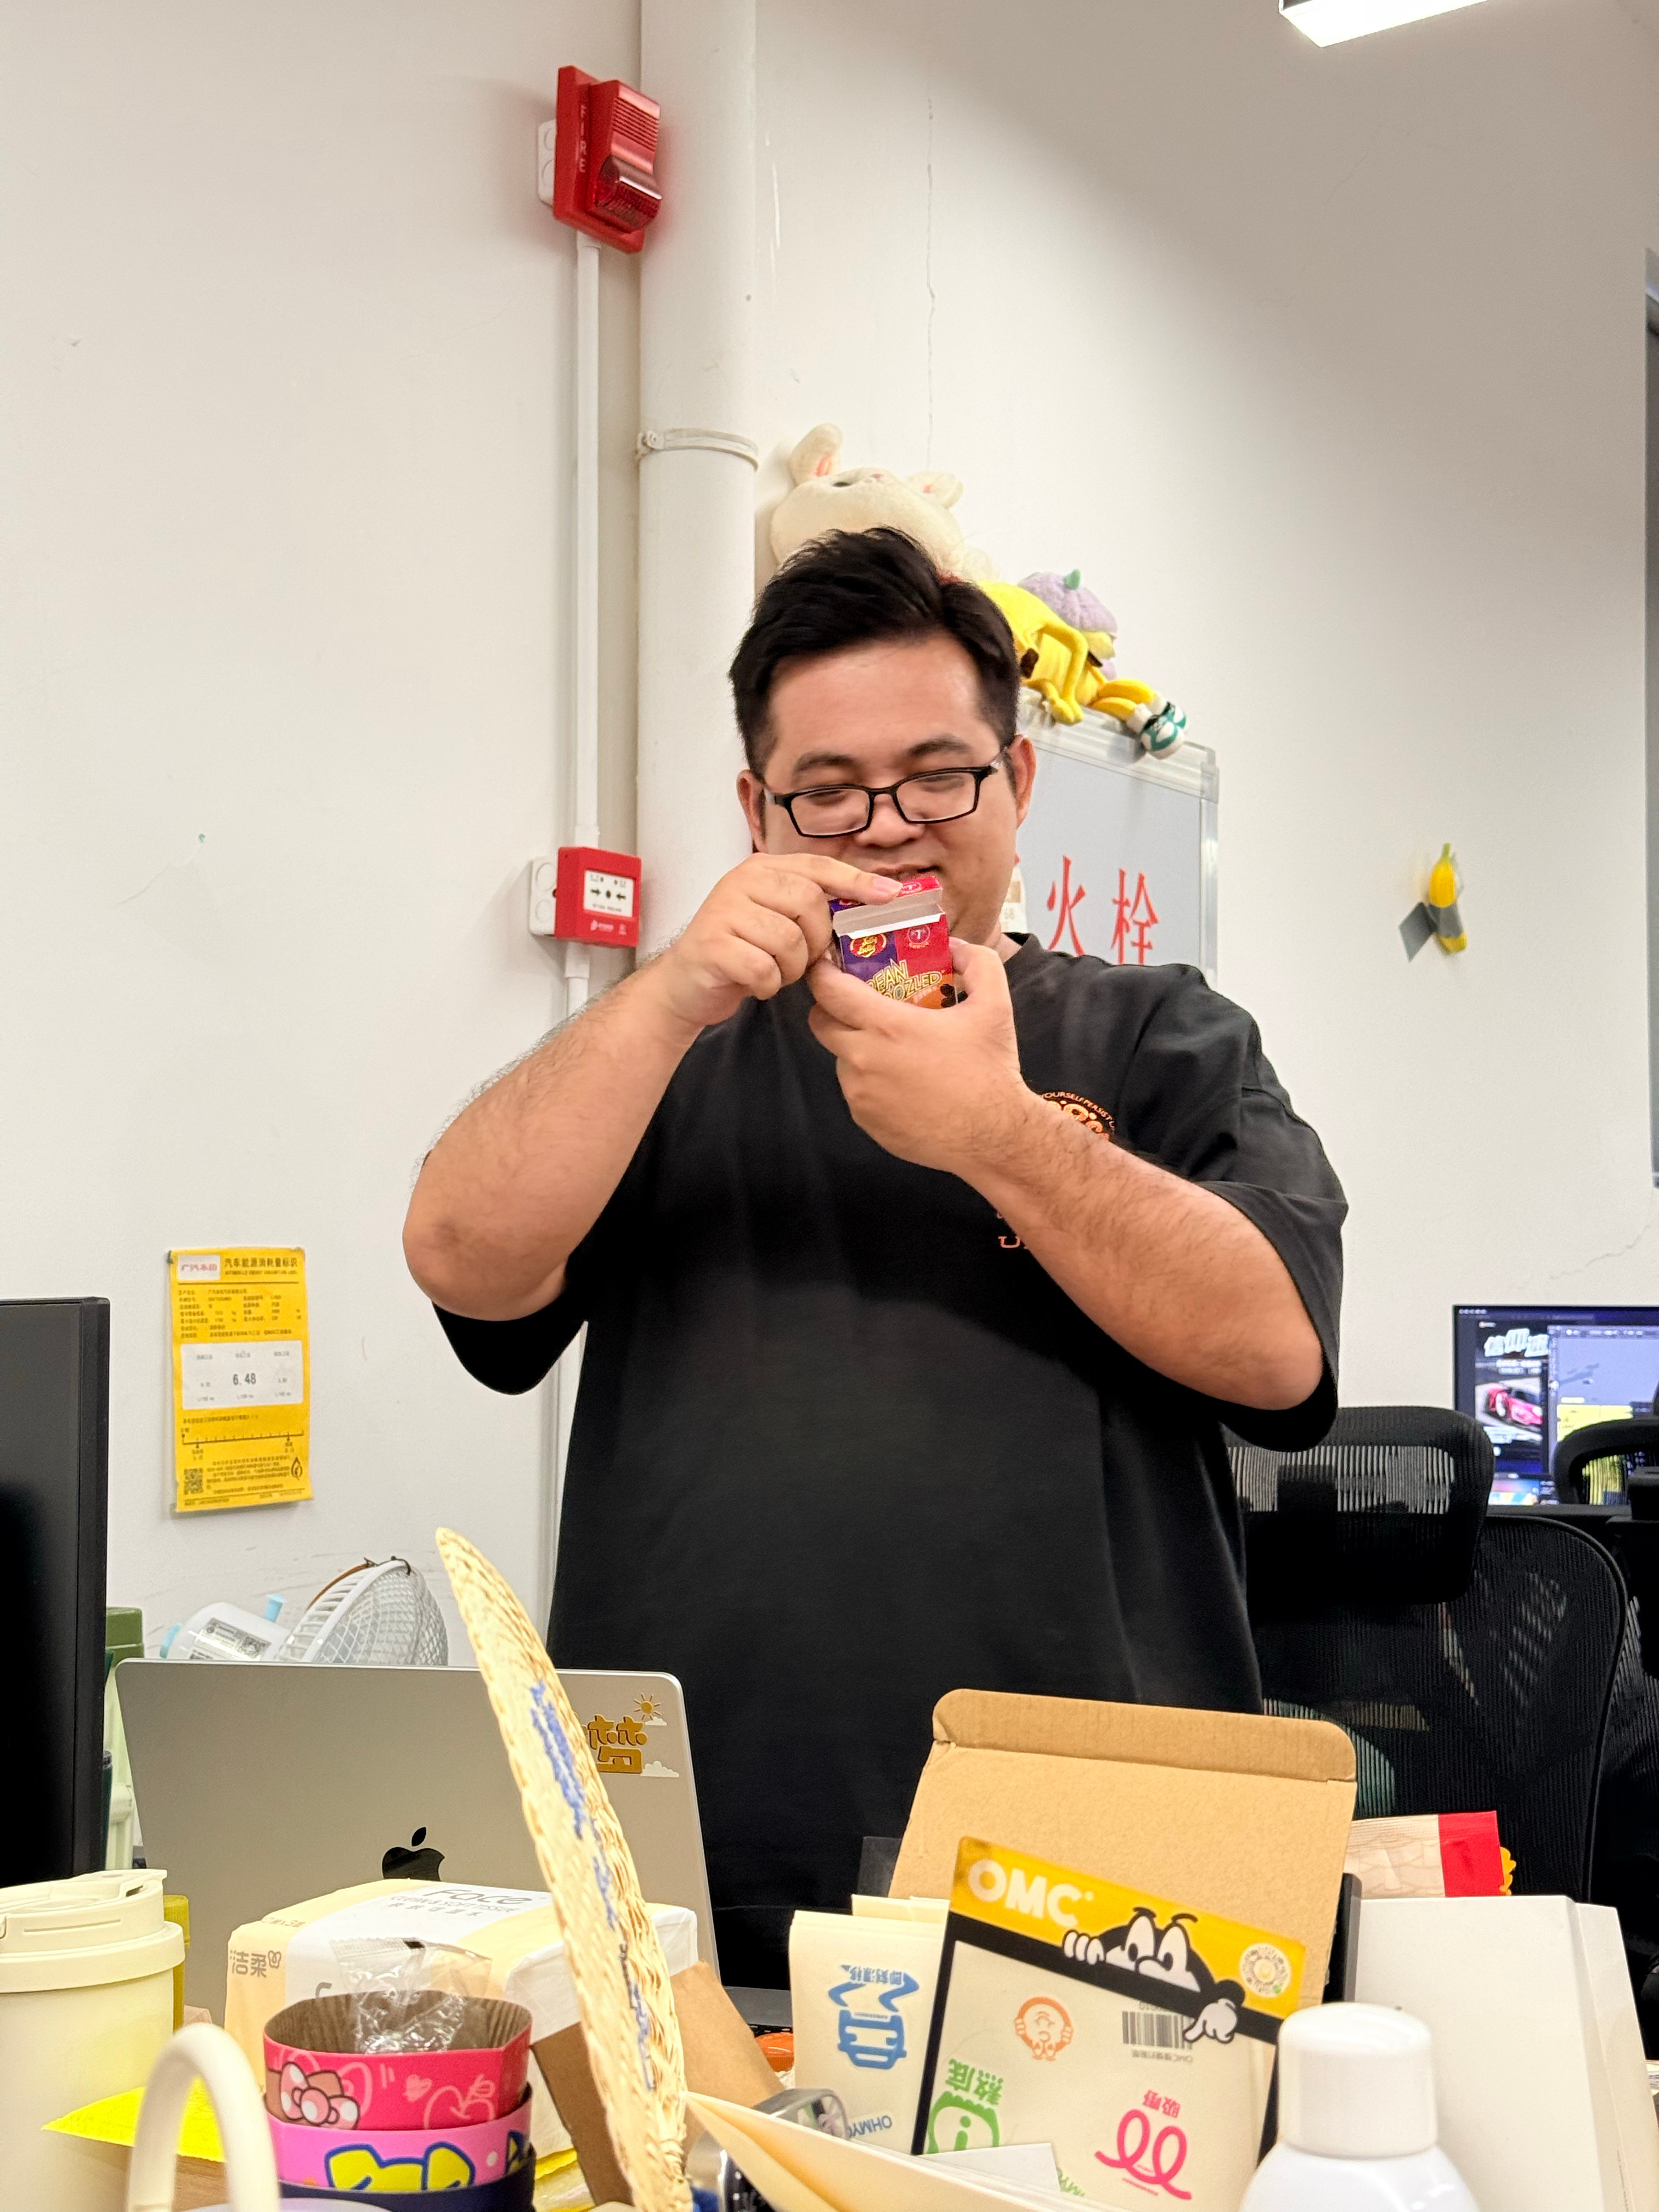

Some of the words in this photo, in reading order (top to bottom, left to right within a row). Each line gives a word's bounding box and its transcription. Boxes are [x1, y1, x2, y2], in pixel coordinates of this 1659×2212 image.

[883, 970, 943, 1002] OZLED
[233, 1373, 257, 1386] 6.48
[422, 1889, 532, 1905] Face
[968, 1858, 1084, 1928] OMC
[229, 1950, 267, 1978] 洁柔
